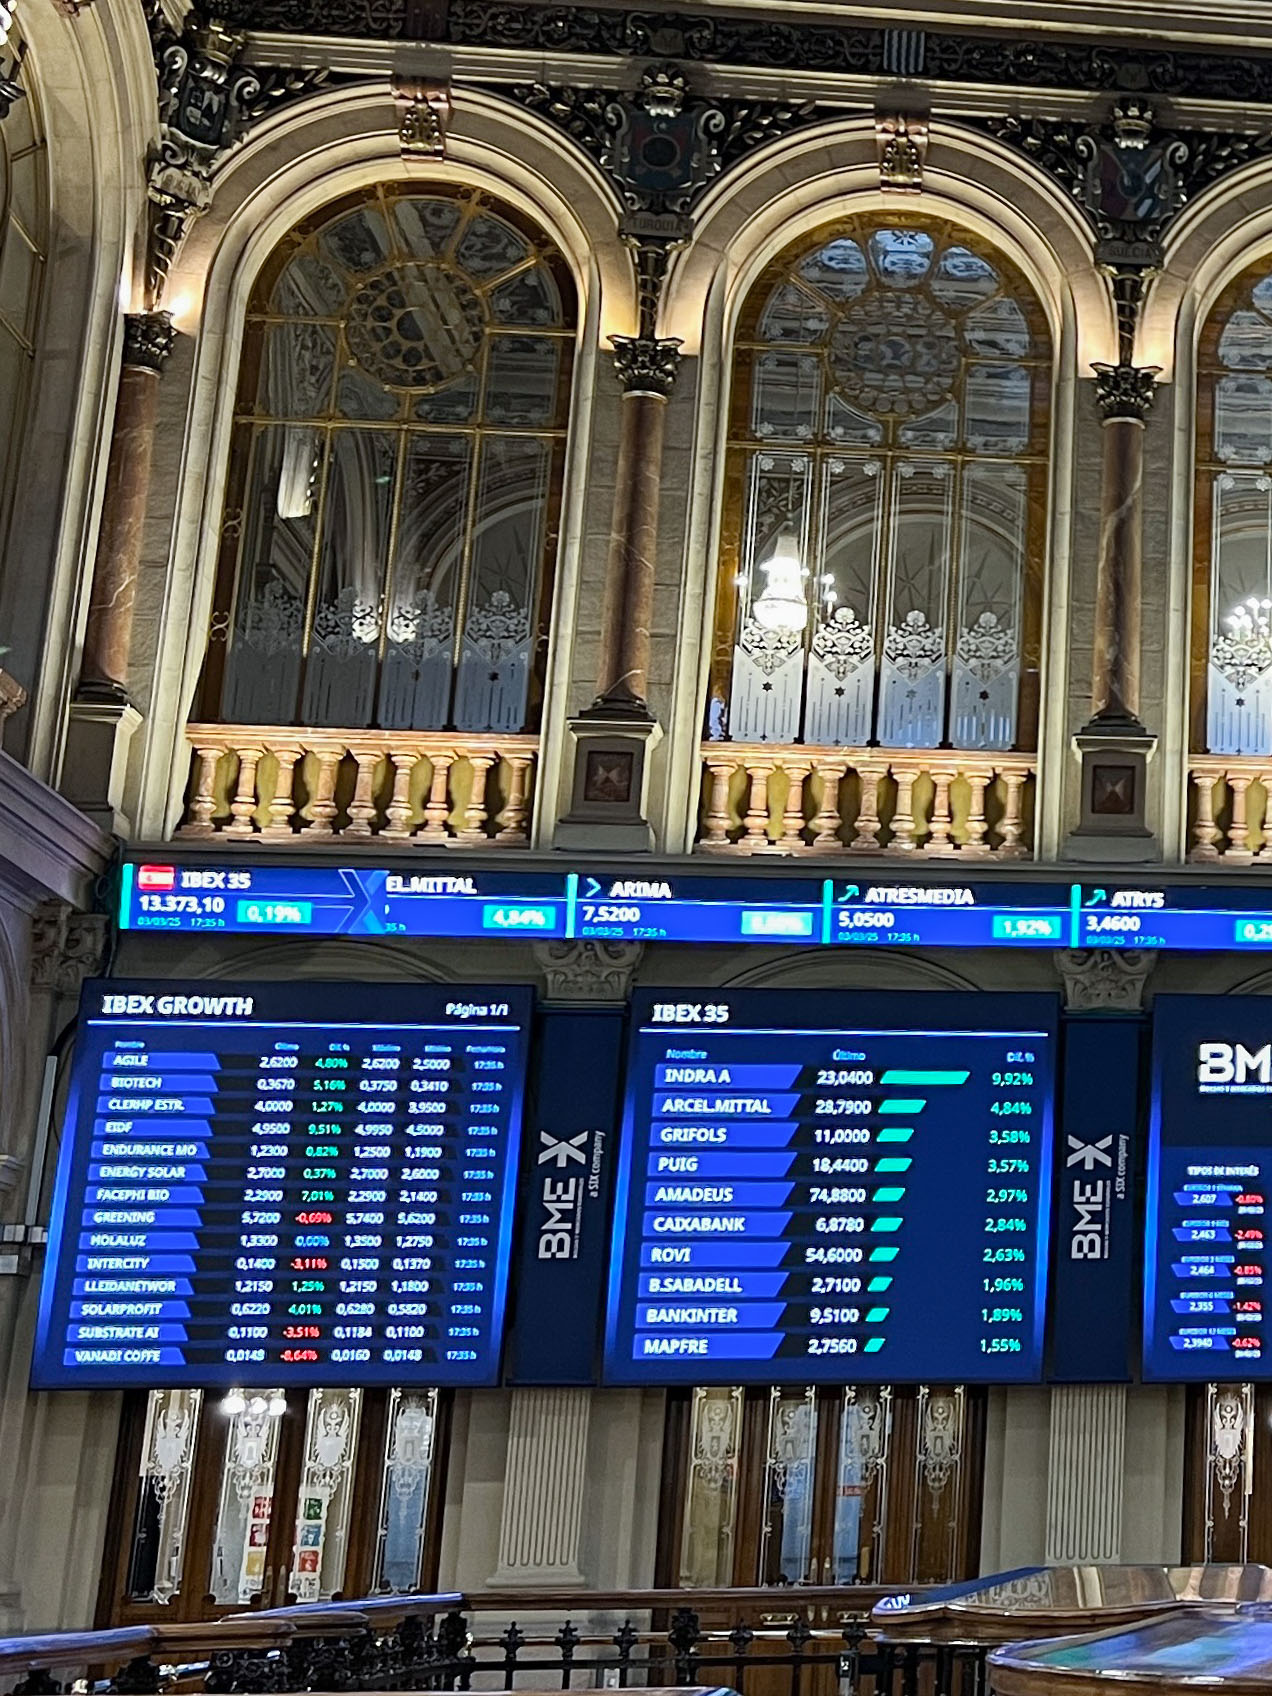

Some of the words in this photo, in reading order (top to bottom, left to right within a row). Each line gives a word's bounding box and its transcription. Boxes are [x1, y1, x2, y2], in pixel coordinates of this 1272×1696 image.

[181, 872, 226, 888] IBEX
[227, 873, 251, 889] 35
[607, 881, 671, 898] ARIMA
[863, 888, 974, 906] ATRESMEDIA
[139, 895, 225, 914] 13.373,10
[1111, 891, 1164, 908] ATRYS
[247, 905, 301, 923] 0,19%
[583, 906, 640, 922] 7,5200
[839, 911, 894, 928] 5,0500
[1086, 916, 1140, 932] 3,4600
[102, 995, 154, 1013] IBEX
[157, 996, 253, 1015] GROWTH
[446, 1003, 487, 1018] Página
[490, 1004, 508, 1015] 1/1
[652, 1004, 701, 1022] IBEX
[703, 1005, 728, 1022] 35
[113, 1055, 148, 1066] AGILE
[111, 1077, 162, 1088] BIOTECH
[664, 1069, 716, 1083] INDRA
[718, 1070, 730, 1082] A
[817, 1070, 873, 1085] 23,0400
[992, 1073, 1033, 1086] 9,92%
[108, 1098, 153, 1110] CLERHP
[991, 1102, 1031, 1115] 4,84%
[661, 1127, 726, 1143] GRIFOLS
[815, 1129, 870, 1144] 11,0000
[989, 1130, 1030, 1144] 3,58%
[103, 1144, 174, 1155] ENDURANCE
[592, 1130, 606, 1174] company
[1118, 1134, 1130, 1176] company
[658, 1157, 698, 1171] PUIG
[813, 1158, 868, 1173] 18,4400
[988, 1160, 1029, 1172] 3,57%
[100, 1166, 146, 1177] ENERGY
[147, 1167, 185, 1178] SOLAR
[588, 1175, 600, 1190] SIX
[1115, 1176, 1126, 1192] SIX
[97, 1189, 148, 1200] FACEPHI
[655, 1188, 733, 1201] AMADEUS
[987, 1189, 1027, 1202] 2,97%
[94, 1212, 154, 1223] GREENING
[538, 1178, 576, 1259] BME
[654, 1217, 745, 1232] CAIXABANK
[1071, 1180, 1104, 1259] BME
[985, 1219, 1026, 1232] 2,84%
[651, 1248, 690, 1262] ROVI
[806, 1248, 862, 1263] 54,6000
[983, 1249, 1024, 1262] 2,63%
[88, 1258, 149, 1269] INTERCITY
[649, 1278, 742, 1292] B.SABADELL
[812, 1278, 861, 1293] 2,7100
[984, 1278, 1023, 1292] 1,96%
[647, 1308, 737, 1323] BANKINTER
[810, 1308, 859, 1324] 9,5100
[982, 1309, 1022, 1323] 1,89%
[644, 1339, 708, 1353] MAPFRE
[808, 1339, 857, 1354] 2,7560
[981, 1339, 1020, 1353] 1,55%
